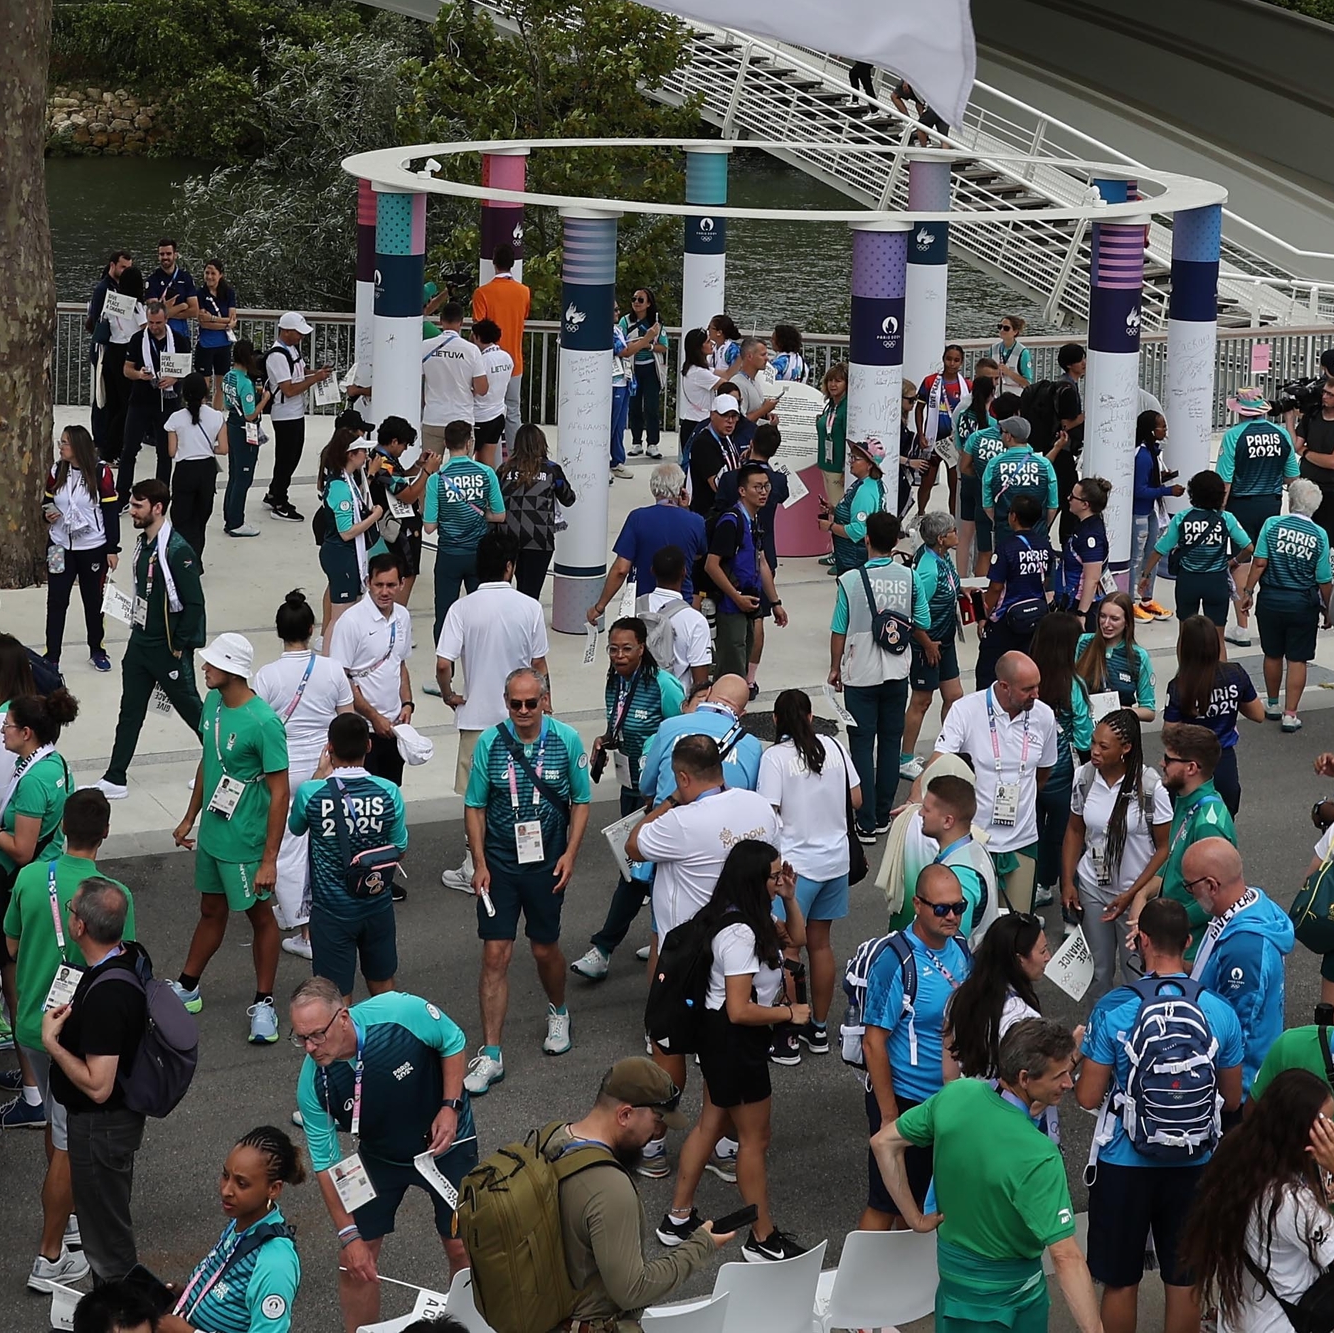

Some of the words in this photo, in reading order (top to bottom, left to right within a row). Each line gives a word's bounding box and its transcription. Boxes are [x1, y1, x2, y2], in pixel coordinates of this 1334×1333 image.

[431, 350, 465, 360] LIETUVA
[979, 448, 999, 461] 20
[1249, 445, 1282, 459] 2024
[446, 488, 484, 503] 2024
[1276, 542, 1313, 561] 2024
[722, 826, 767, 849] MOLDOVA
